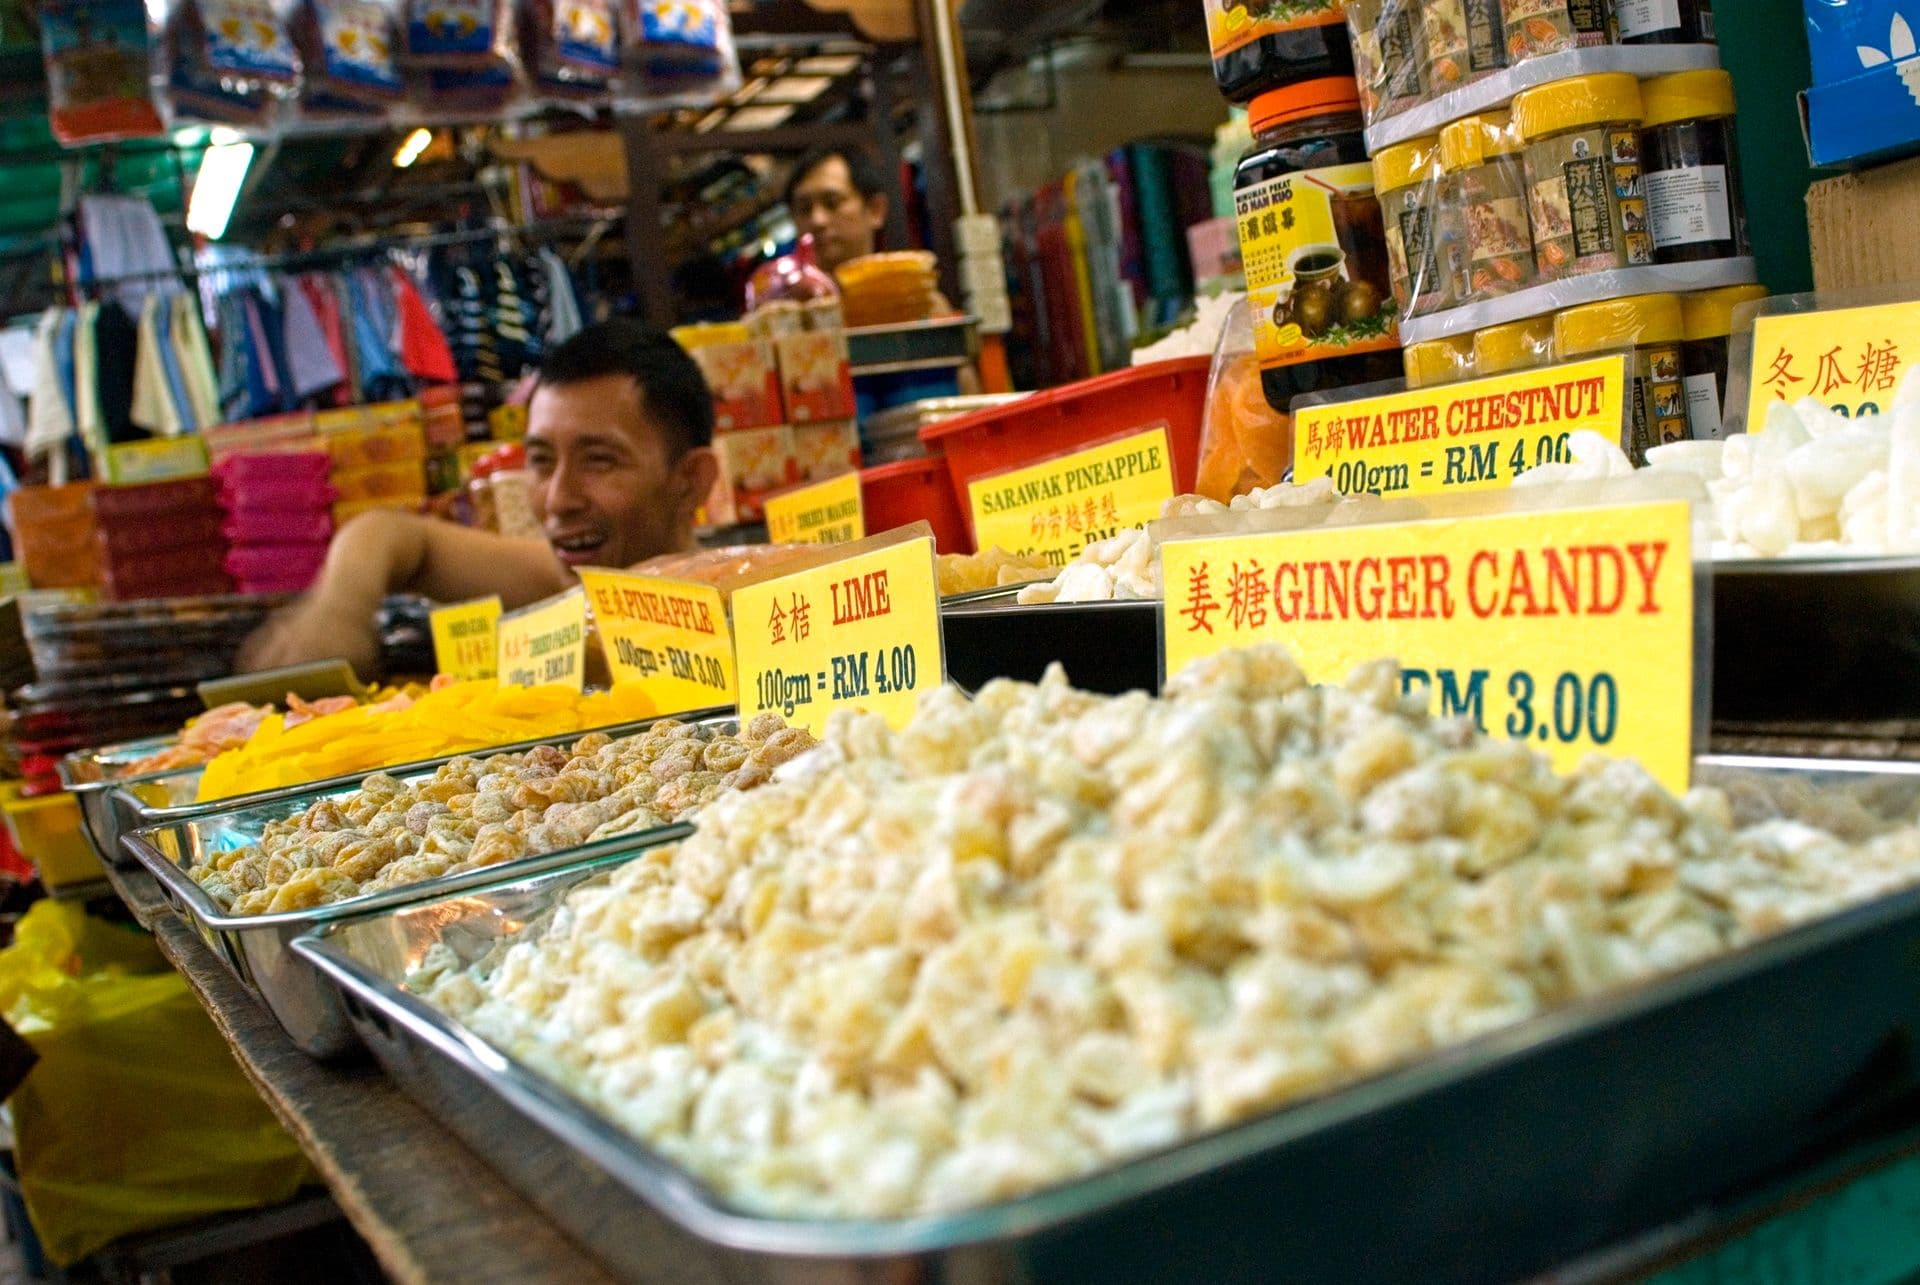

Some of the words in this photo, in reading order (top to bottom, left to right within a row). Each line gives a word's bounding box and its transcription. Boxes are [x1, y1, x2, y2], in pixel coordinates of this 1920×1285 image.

[1237, 202, 1248, 215] LO
[1250, 195, 1270, 213] HAN
[1271, 188, 1293, 205] KUO
[1269, 179, 1291, 194] PEKAT
[1762, 339, 1901, 400] 冬瓜糖
[1346, 406, 1440, 450] WATER
[1446, 376, 1605, 436] CHESTNUT
[982, 474, 1063, 514] SARAWAK
[1065, 446, 1161, 494] PINEAPPLE
[1443, 441, 1499, 486] RM
[623, 589, 715, 635] PINEAPPLE
[768, 592, 810, 645] 金桔
[830, 570, 890, 626] LIME
[1180, 558, 1270, 634] 姜糖
[1273, 555, 1455, 622] GINGER
[1467, 541, 1669, 619] CANDY
[614, 636, 659, 677] 100gm
[665, 646, 697, 682] RM
[695, 653, 726, 690] 3.00
[757, 668, 812, 717] 100gm
[831, 652, 869, 700] RM
[875, 644, 916, 694] 4.00
[1506, 670, 1618, 745] 3.00
